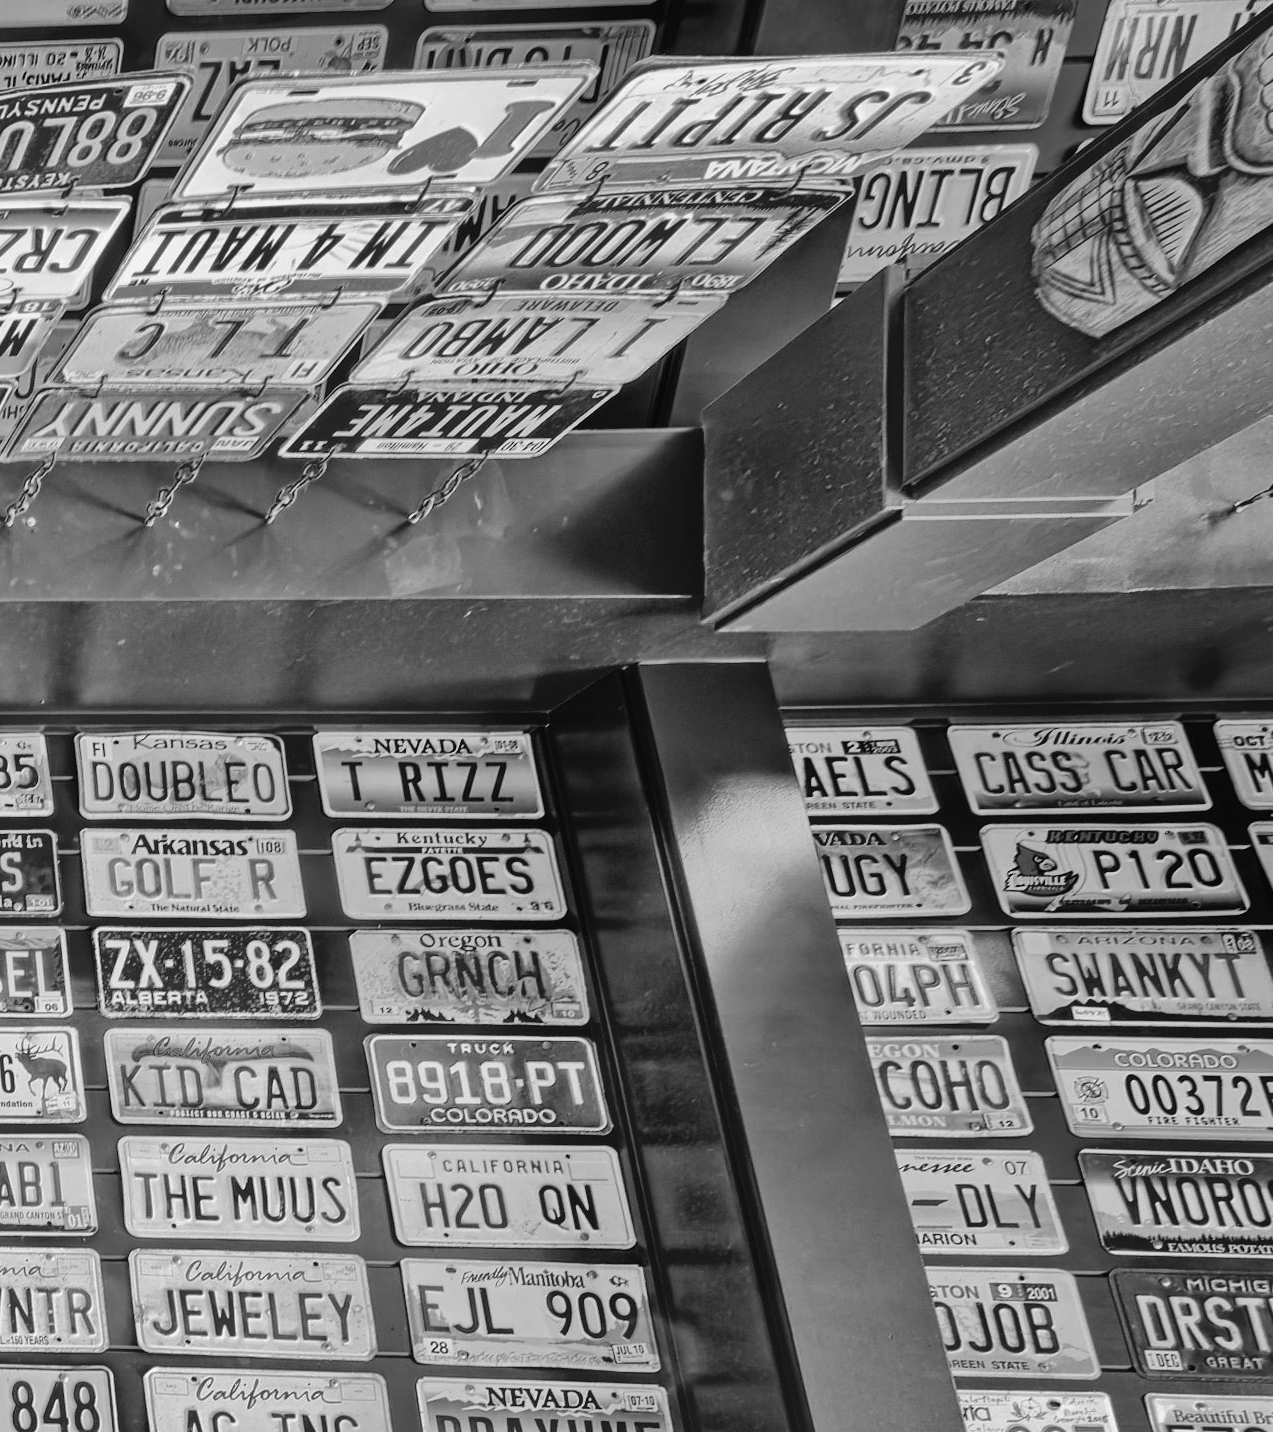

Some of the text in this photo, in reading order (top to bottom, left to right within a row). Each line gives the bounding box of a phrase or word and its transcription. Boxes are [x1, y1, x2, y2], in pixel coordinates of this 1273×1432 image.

[38, 401, 283, 437] SUNNNY
[342, 762, 515, 803] T RIZZ
[976, 749, 1194, 793] CASS CAR
[131, 834, 248, 855] Arkansas
[365, 857, 534, 895] EZGOES
[1046, 952, 1246, 999] SWANKYT
[428, 1109, 557, 1126] COLORADO
[1148, 1116, 1239, 1126] FIRE FIGHTER
[152, 1291, 353, 1343] JEWELEY
